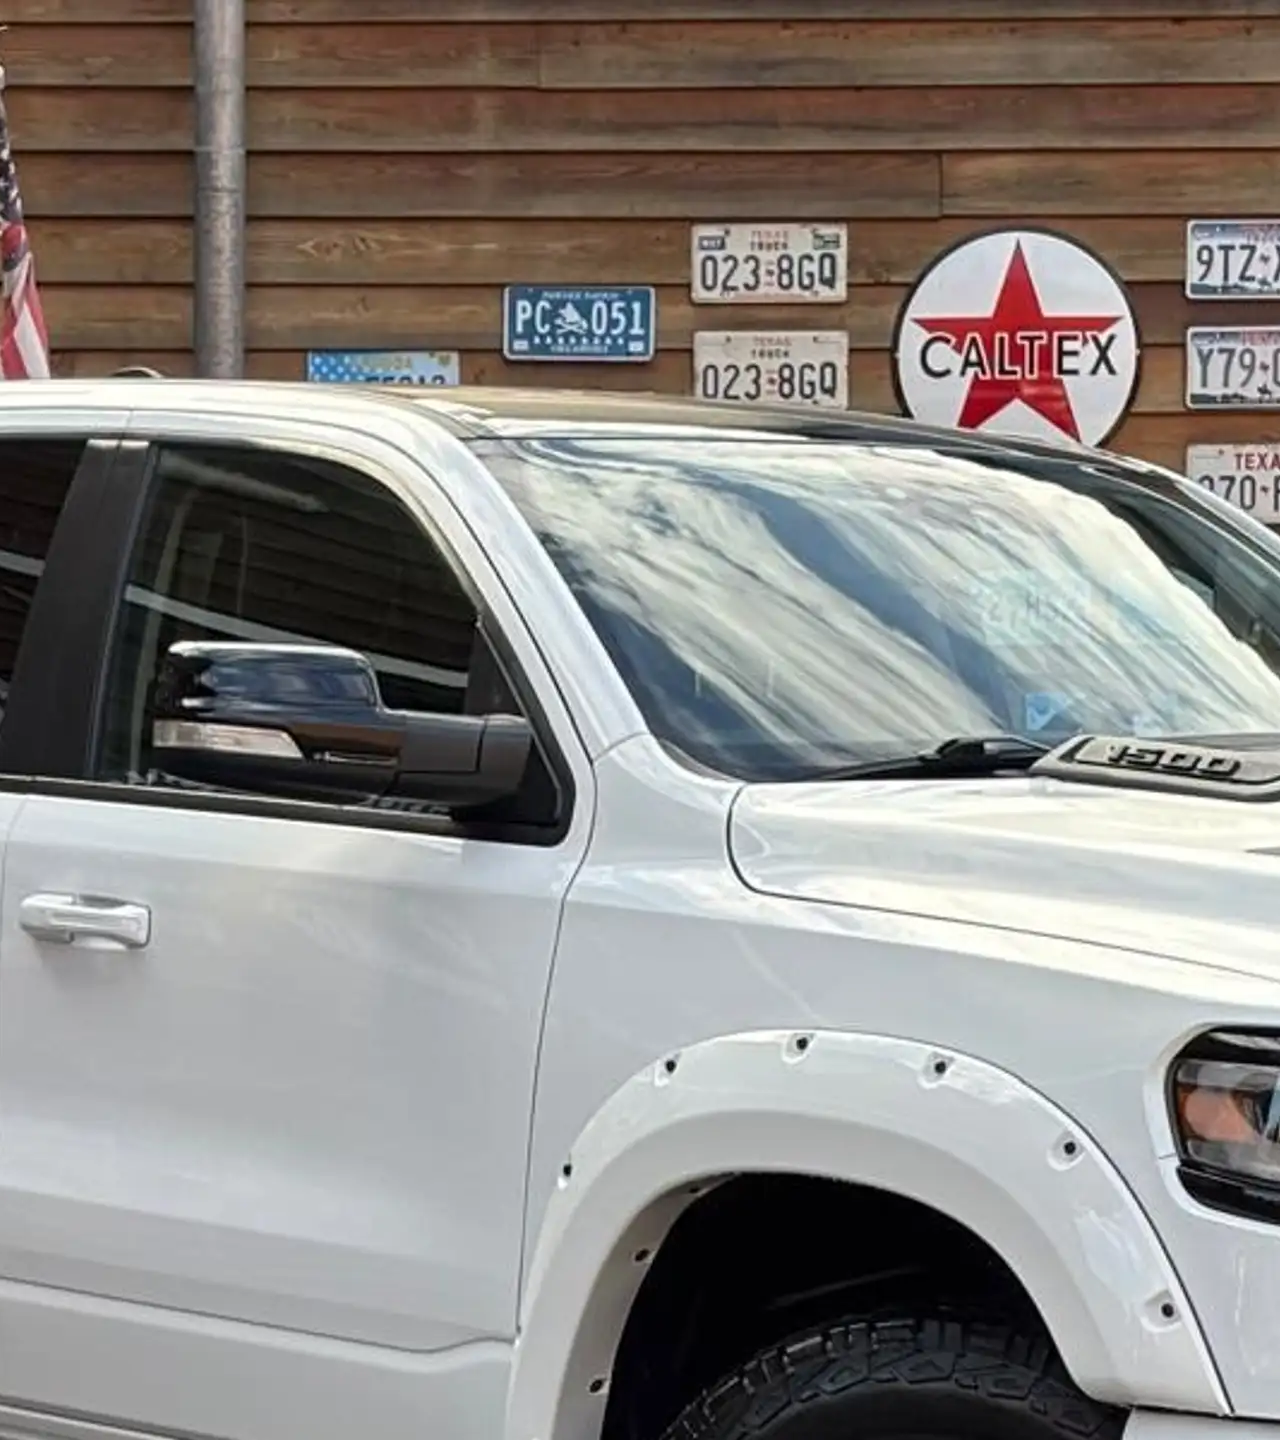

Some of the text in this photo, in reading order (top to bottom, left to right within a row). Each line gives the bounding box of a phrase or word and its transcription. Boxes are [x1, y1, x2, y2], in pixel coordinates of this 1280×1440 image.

[515, 300, 645, 335] PC 051
[919, 332, 1118, 380] CALTEX
[1107, 744, 1242, 777] 1500
